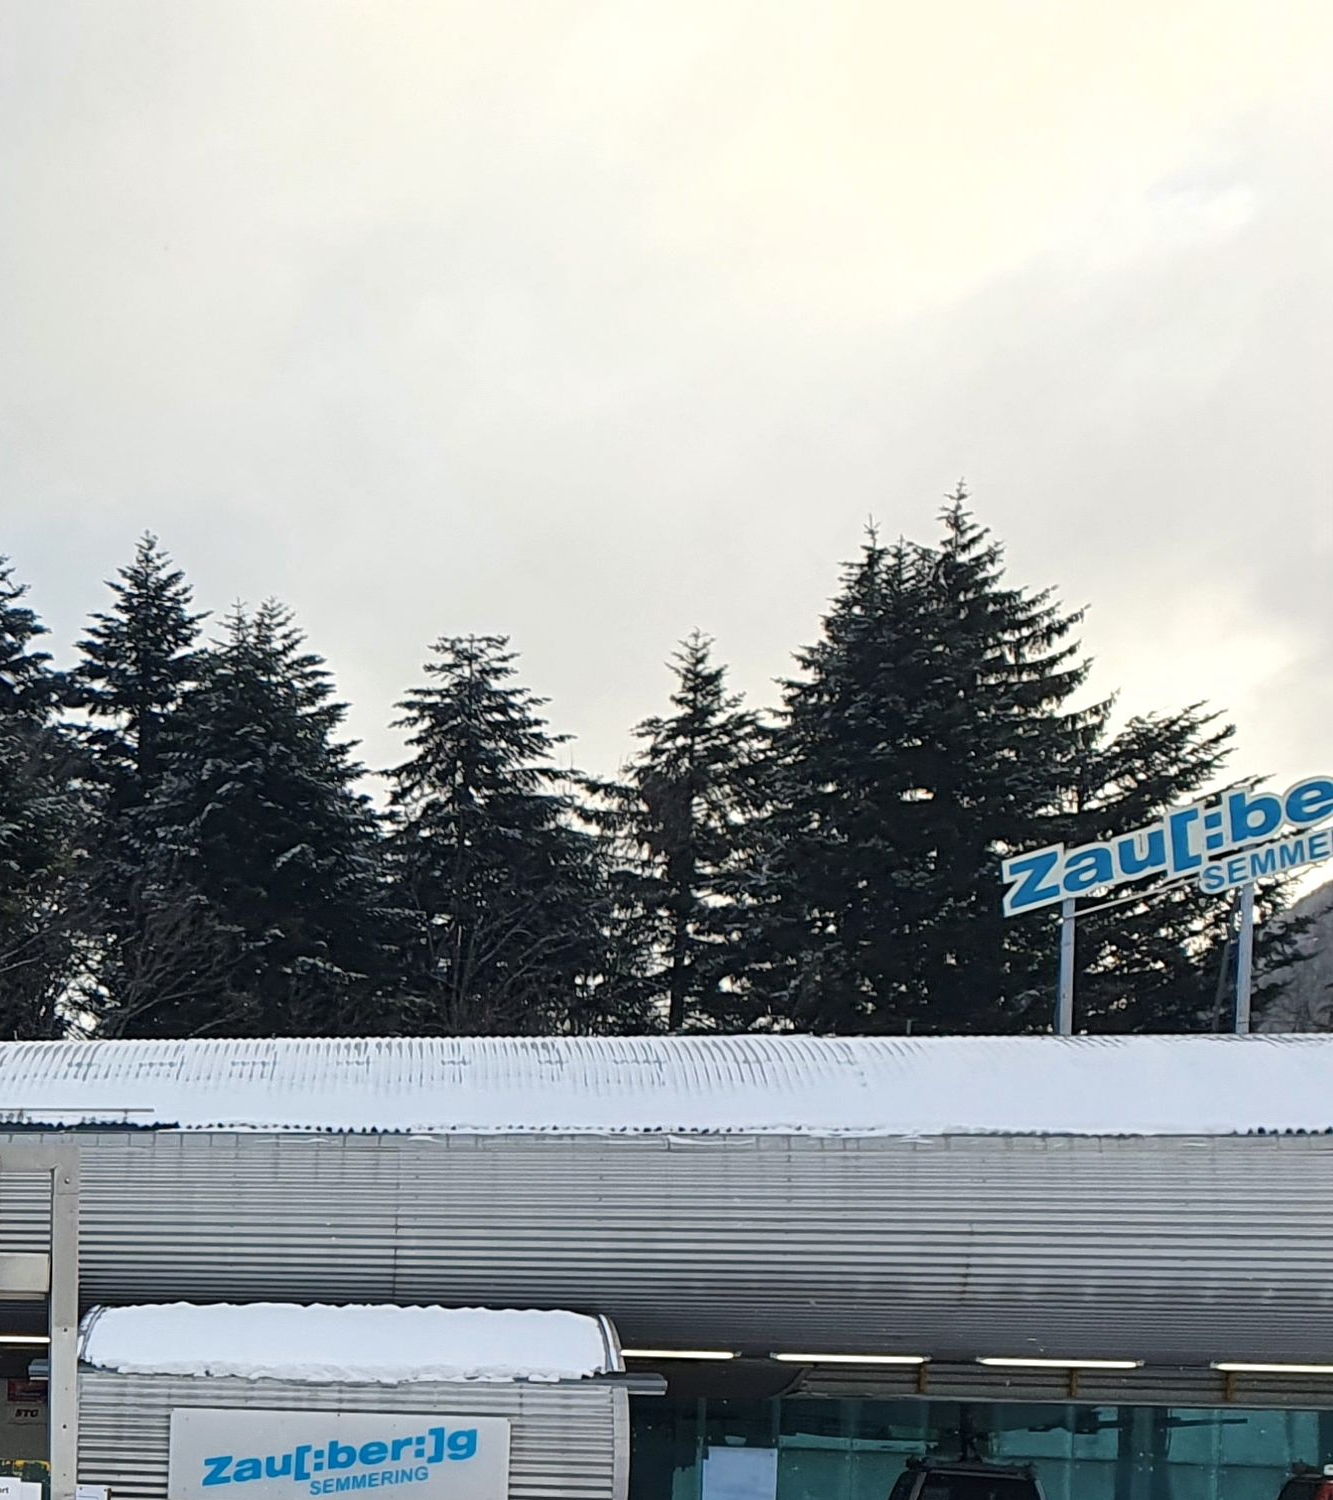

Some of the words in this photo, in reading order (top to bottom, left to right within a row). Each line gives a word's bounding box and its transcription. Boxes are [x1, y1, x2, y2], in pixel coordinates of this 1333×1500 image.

[1203, 830, 1333, 891] SEMME
[202, 1426, 477, 1487] Zau[:ber:]g
[309, 1465, 429, 1496] SEMMERING
